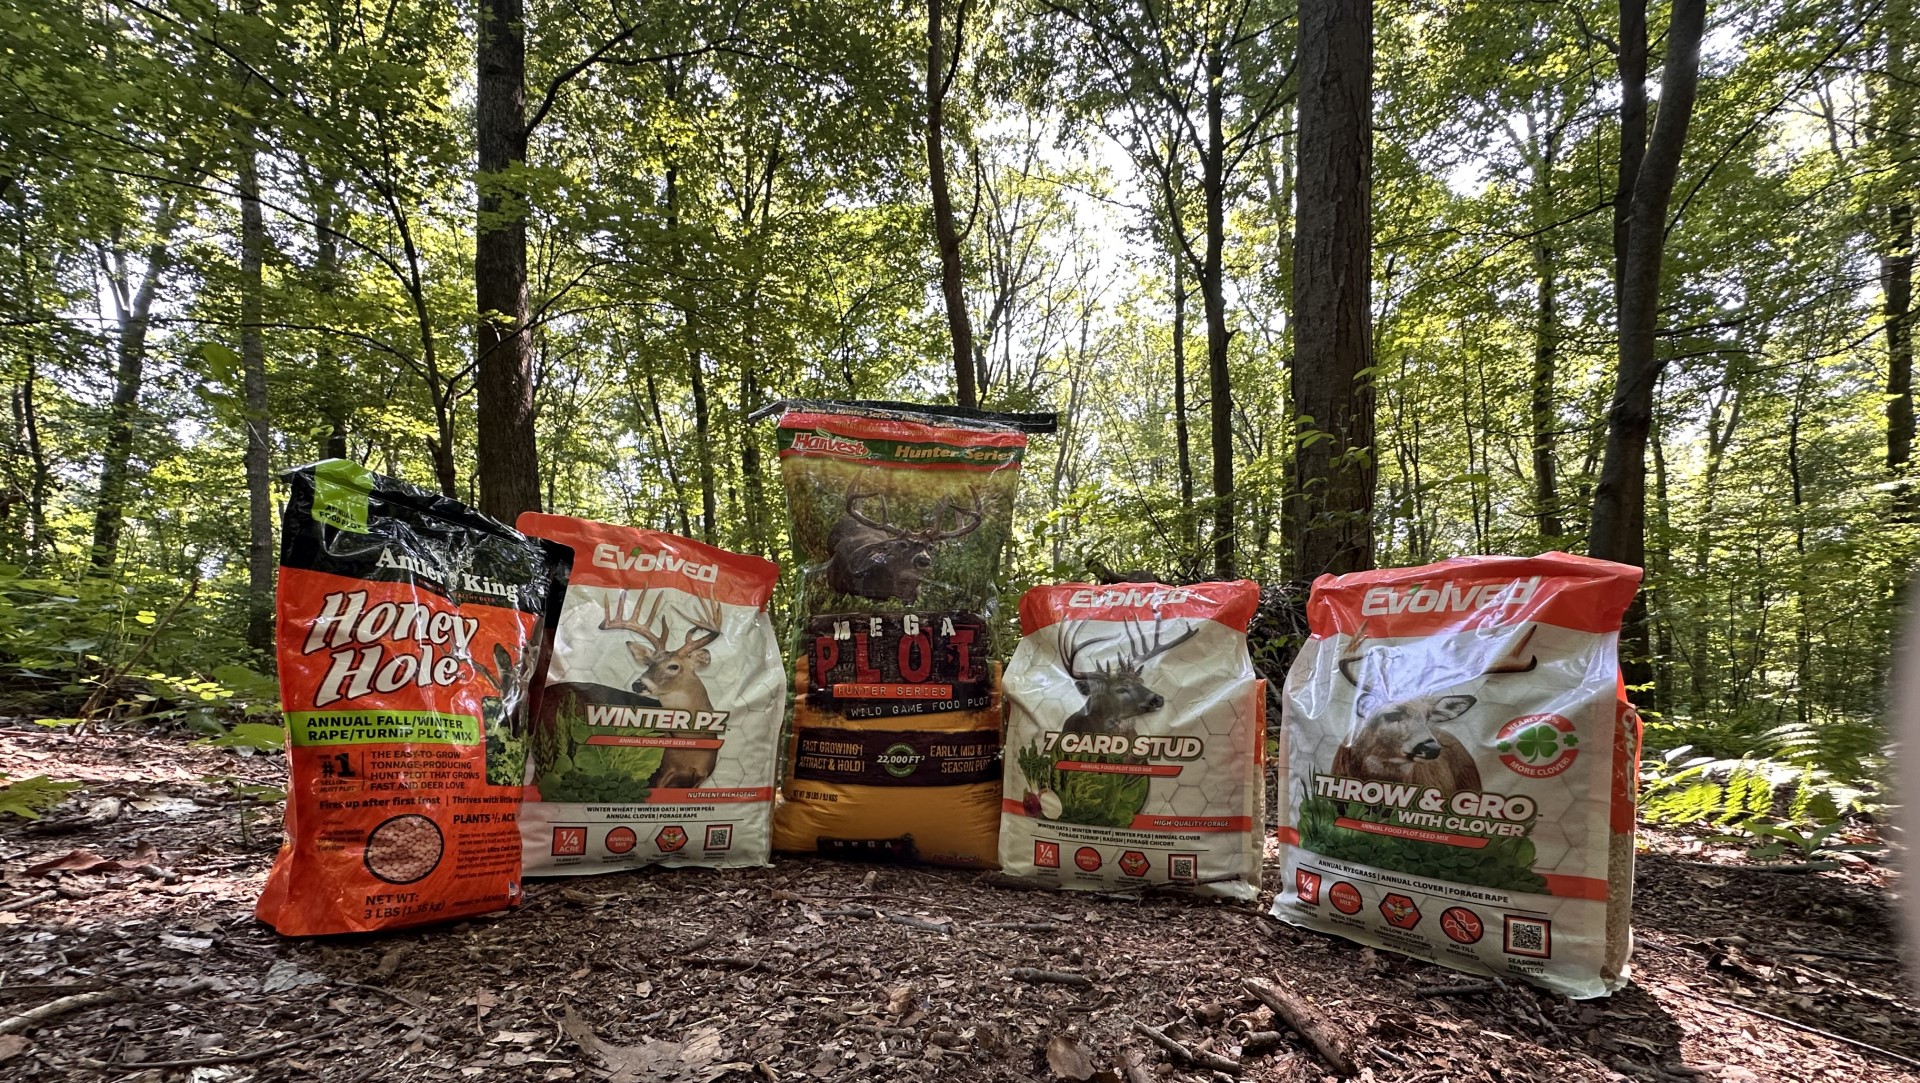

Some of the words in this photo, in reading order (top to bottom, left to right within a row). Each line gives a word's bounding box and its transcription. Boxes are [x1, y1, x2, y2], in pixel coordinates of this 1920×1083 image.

[835, 408, 866, 416] Hunter
[868, 410, 893, 418] Series
[791, 432, 864, 457] Harvest
[894, 445, 960, 459] Hunter
[964, 448, 1015, 461] Series
[319, 511, 341, 523] FOOD
[326, 505, 355, 521] ANNUAL
[592, 544, 718, 583] Evolved
[375, 547, 445, 584] Antler
[462, 573, 520, 602] King
[1068, 588, 1189, 608] Evolved
[1361, 576, 1542, 617] Evolved
[303, 589, 478, 658] Honey
[833, 614, 956, 641] MEGA
[815, 628, 977, 687] PLOT
[315, 644, 459, 708] Hole
[838, 686, 887, 696] HUNTER
[896, 687, 947, 696] SERIES
[851, 707, 882, 717] WILD
[892, 704, 923, 715] GAME
[932, 700, 960, 711] FOOD
[967, 697, 989, 707] PLOT
[307, 716, 373, 728] ANNUAL
[376, 716, 464, 729] FALL/WINTER
[586, 704, 692, 730] WINTER
[693, 710, 730, 732] PZ
[1507, 715, 1539, 732] NEARLY
[308, 729, 414, 742] RAPE/TURNIP
[417, 729, 449, 739] PLOT
[452, 731, 473, 741] MIX
[802, 740, 819, 752] FAST
[930, 745, 958, 757] EARLY,
[960, 745, 975, 756] MID
[1045, 733, 1061, 751] 7
[1061, 733, 1129, 755] CARD
[1132, 735, 1203, 758] STUD
[370, 751, 391, 759] THE
[393, 750, 461, 759] EASY-TO-GROW
[876, 755, 908, 765] 22,000
[322, 753, 356, 778] #1
[371, 761, 472, 769] TONNAGE-PRODUCING
[799, 756, 828, 770] ATTRACT
[828, 758, 836, 771] &
[941, 761, 973, 773] SEASON
[1510, 760, 1536, 776] MORE
[1536, 757, 1570, 776] CLOVER!
[370, 772, 400, 780] HUNT
[403, 771, 428, 779] PLOT
[430, 771, 450, 779] THAT
[452, 771, 480, 779] GROWS
[370, 782, 396, 791] FAST
[398, 782, 419, 790] AND
[446, 781, 465, 789] LOVE
[319, 801, 344, 809] Fires
[345, 800, 359, 809] up
[362, 798, 390, 807] after
[392, 796, 415, 806] first
[418, 795, 441, 805] frost
[452, 796, 481, 804] Thrives
[483, 795, 499, 804] with
[687, 791, 735, 799] NUTRIENT-RICH
[1315, 775, 1419, 809] THROW
[1418, 788, 1448, 813] &
[1450, 791, 1537, 822] GRO
[453, 814, 490, 824] PLANTS
[1153, 819, 1202, 827] HIGH-QUALITY
[1397, 810, 1444, 828] WITH
[1445, 817, 1525, 838] CLOVER
[561, 831, 579, 846] 1/4
[1361, 823, 1384, 832] ANNUAL
[1384, 827, 1402, 835] FOOD
[1402, 829, 1419, 837] PLOT
[1419, 831, 1436, 840] SEED
[1435, 834, 1449, 842] MIX
[1039, 844, 1053, 859] 1/4
[1300, 874, 1314, 892] 1/4
[1318, 860, 1343, 871] ANNUAL
[1343, 865, 1377, 879] RYEGRASS
[1381, 874, 1412, 887] ANNUAL
[1412, 881, 1444, 893] CLOVER
[1449, 888, 1484, 900] FORAGE
[1485, 893, 1509, 903] RAPE
[365, 894, 394, 905] NET
[396, 892, 420, 904] WT:
[1332, 890, 1359, 902] ANNUAL
[1339, 898, 1352, 906] MIX
[364, 909, 372, 919] 3
[375, 907, 400, 918] LBS
[1379, 925, 1402, 934] YELLOW
[1402, 931, 1424, 941] JACKET
[1450, 943, 1475, 954] NO-TILL
[1507, 957, 1545, 967] SEASONAL
[1508, 964, 1544, 974] STRATEGY
